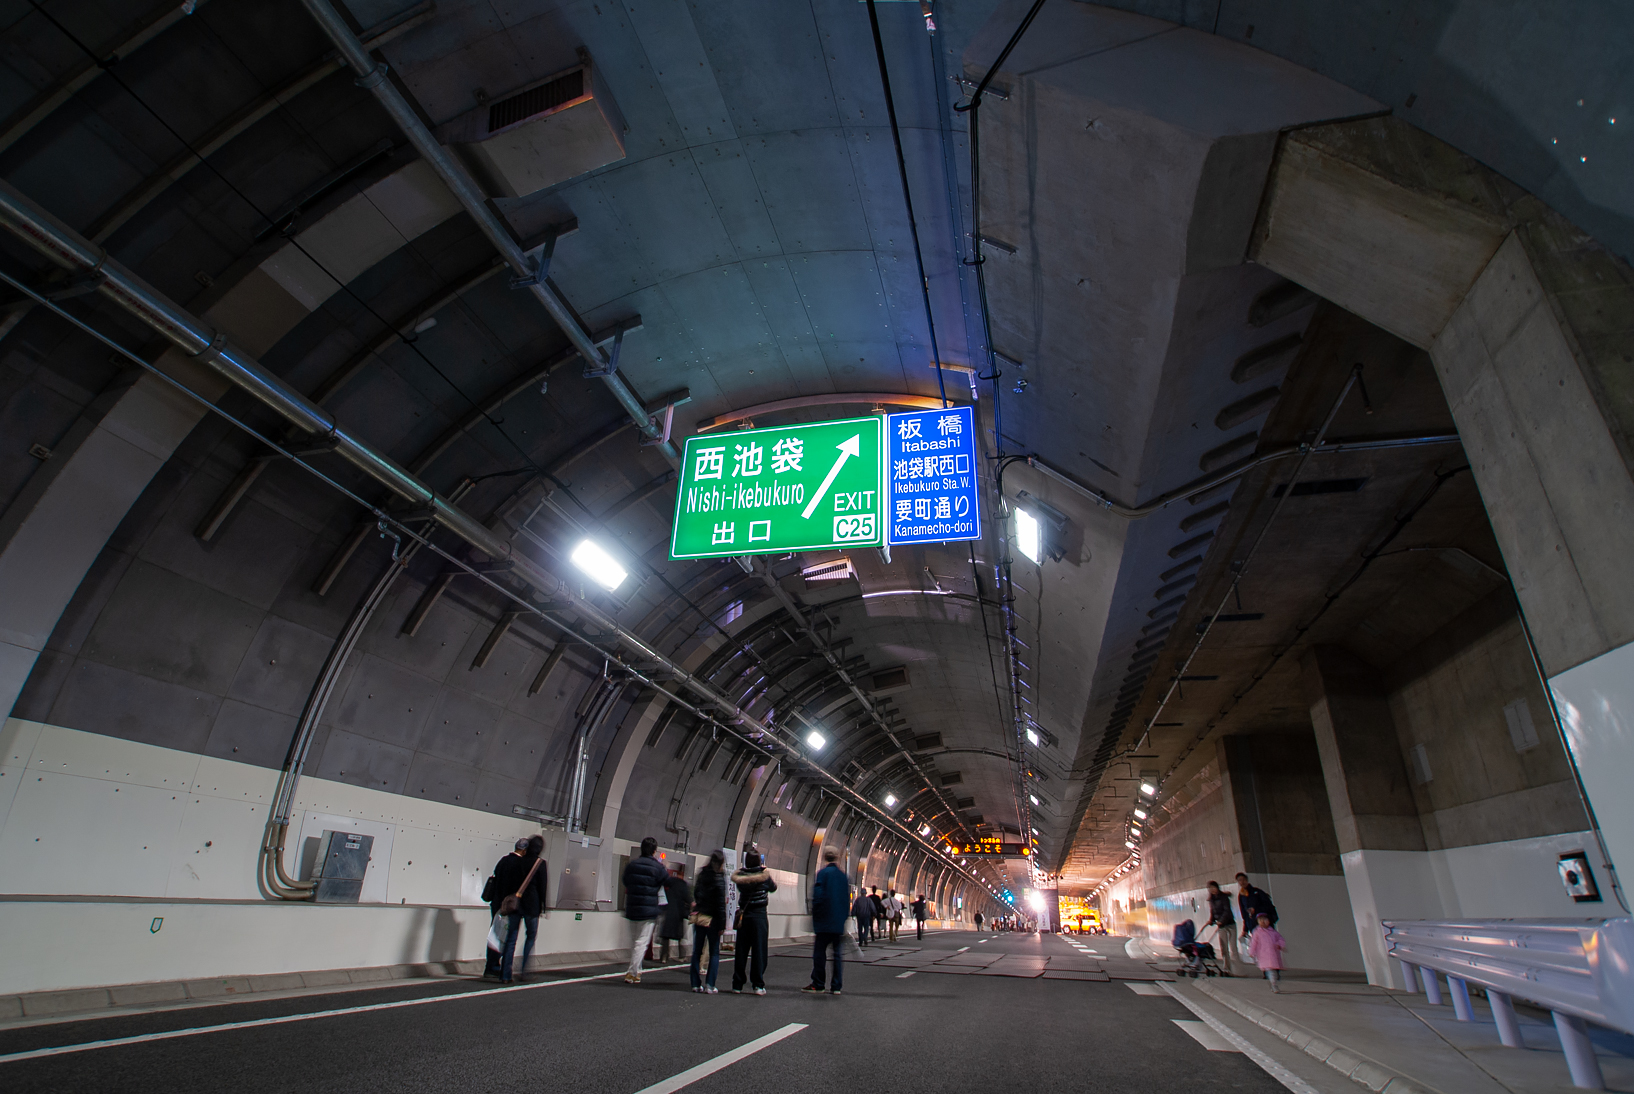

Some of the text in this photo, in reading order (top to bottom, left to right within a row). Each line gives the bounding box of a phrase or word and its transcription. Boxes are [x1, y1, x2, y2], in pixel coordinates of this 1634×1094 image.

[897, 414, 963, 440] 板橋
[901, 436, 961, 453] Itabashi
[694, 437, 804, 482] 西池袋
[893, 453, 970, 481] 池袋駅西口
[686, 479, 805, 514] Nishi-ikebukuro
[894, 476, 972, 494] Ikebukuro Sta. W.
[834, 490, 876, 512] EXIT
[895, 495, 970, 523] 要町通り
[711, 519, 772, 546] 出口
[835, 516, 873, 539] C25
[894, 519, 974, 537] Kanamecho-dori
[963, 843, 1002, 854] ようこそ
